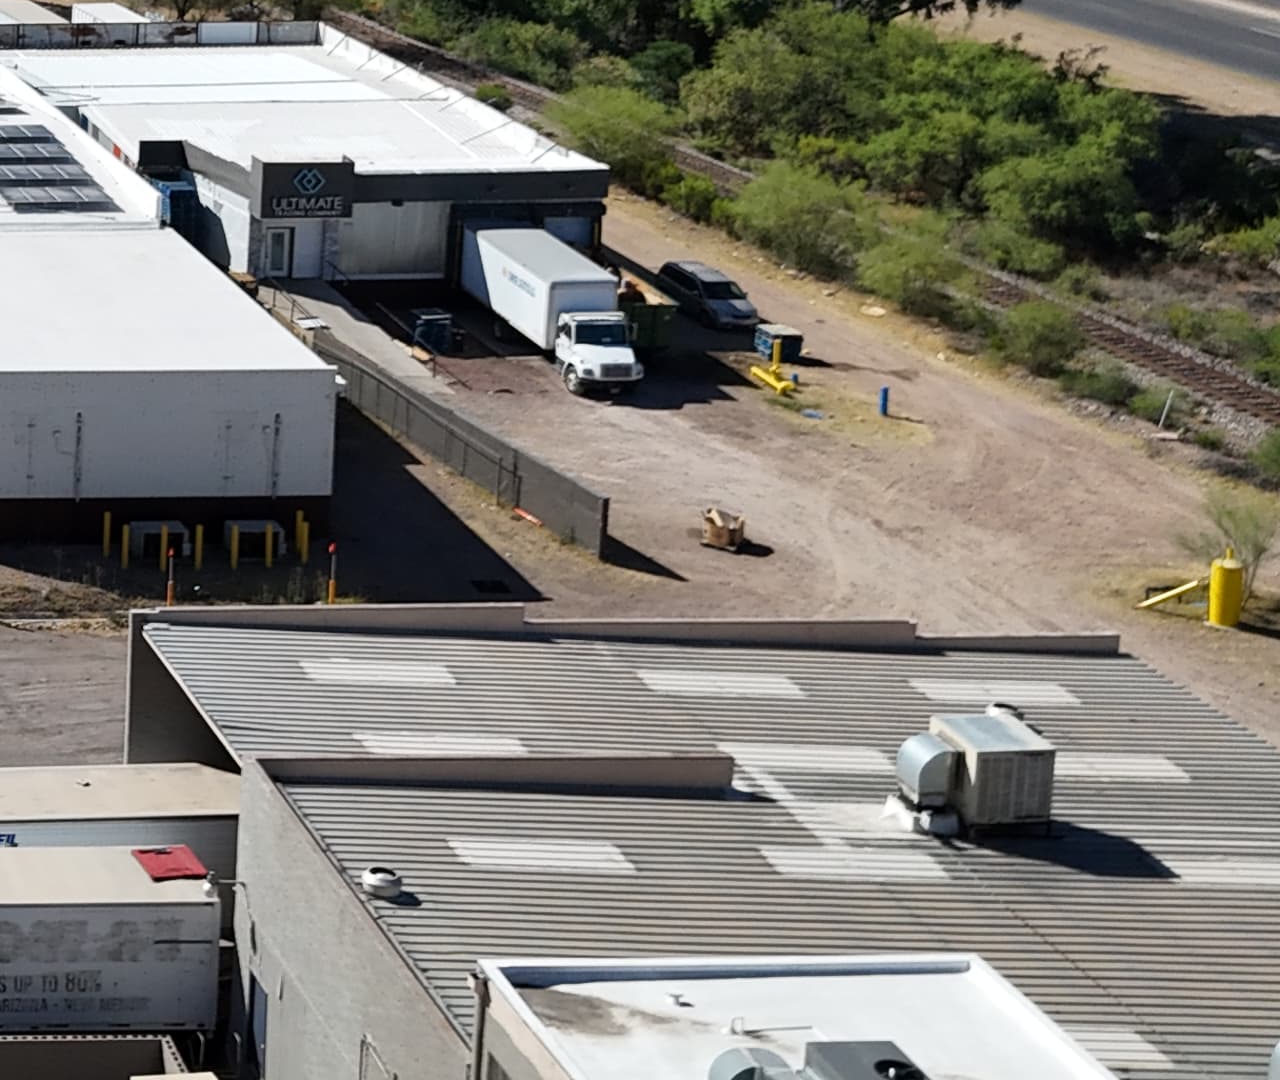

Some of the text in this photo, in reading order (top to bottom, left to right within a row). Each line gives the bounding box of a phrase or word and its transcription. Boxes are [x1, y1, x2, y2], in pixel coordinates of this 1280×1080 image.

[272, 196, 343, 210] ULTIMATE
[14, 975, 33, 993] UP
[42, 975, 59, 993] TO
